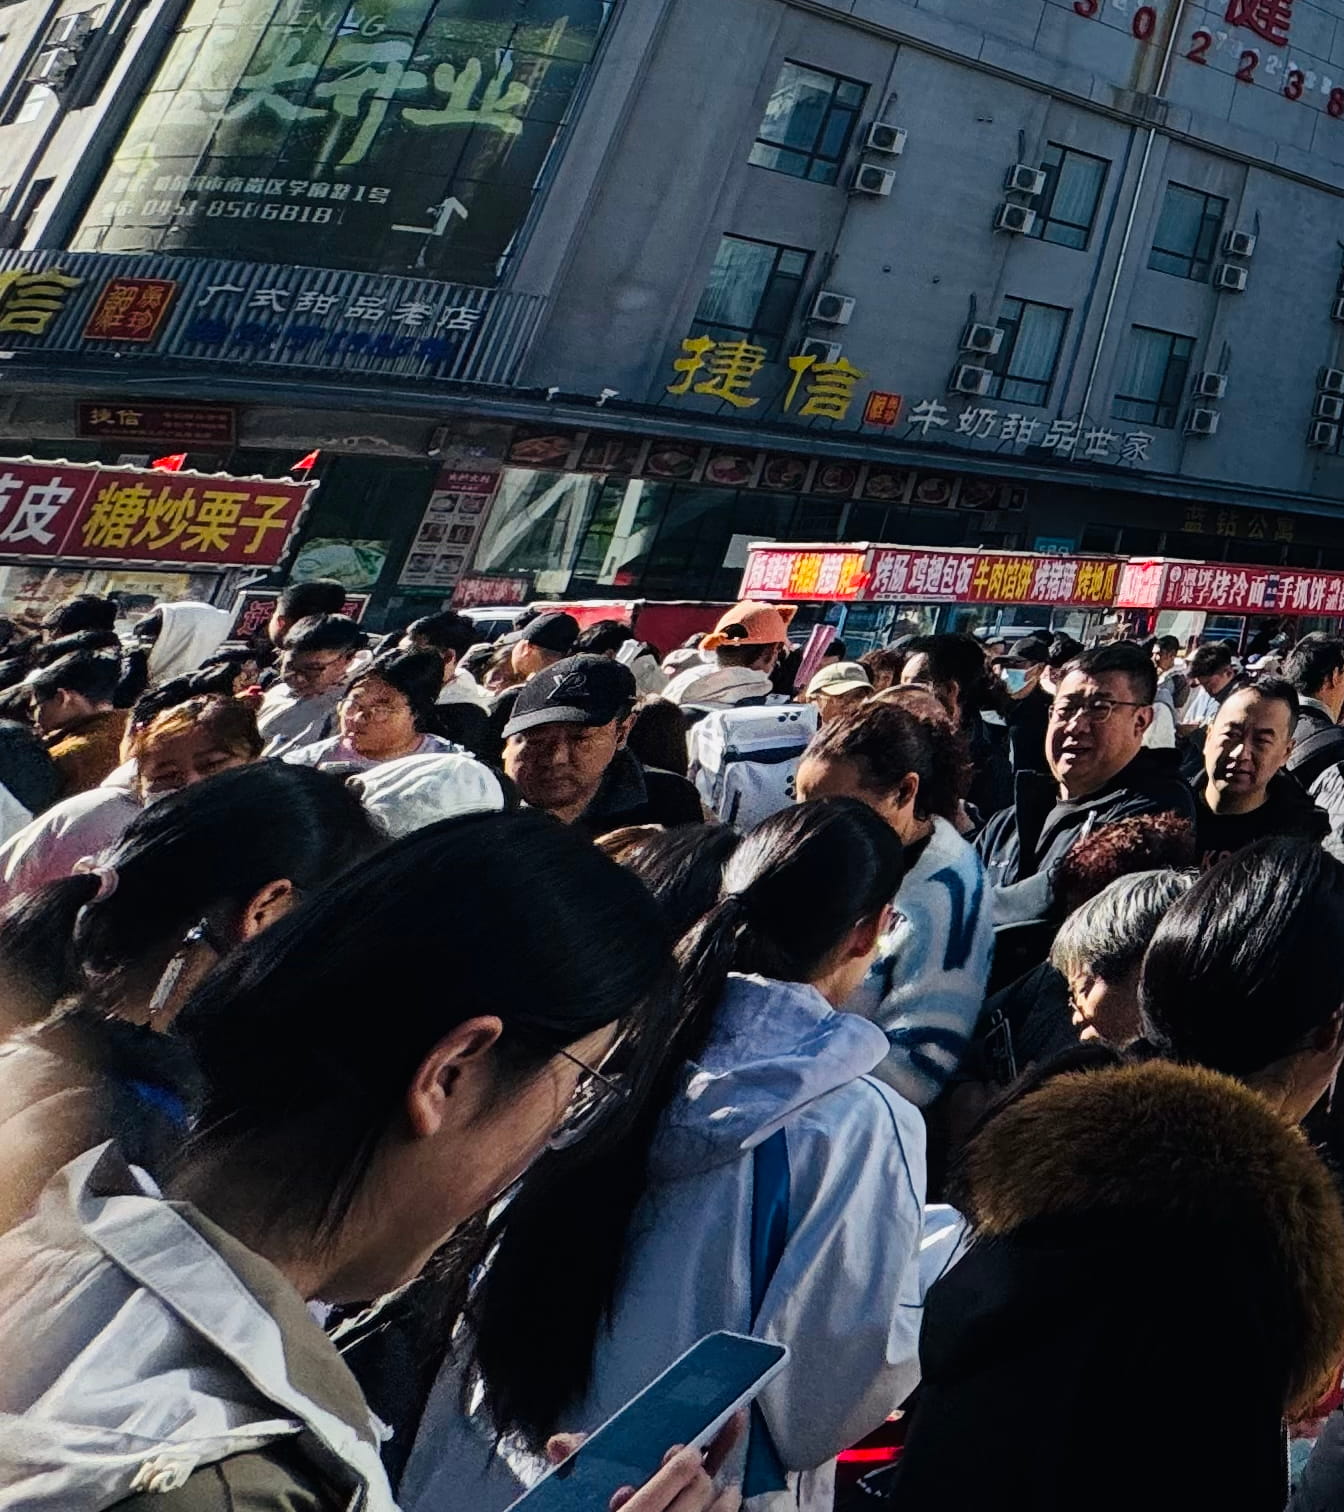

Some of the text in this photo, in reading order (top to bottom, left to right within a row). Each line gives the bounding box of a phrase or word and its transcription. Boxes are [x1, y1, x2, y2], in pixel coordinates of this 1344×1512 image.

[201, 284, 485, 332] 广式甜品老店
[666, 334, 869, 420] 捷信
[906, 397, 1158, 462] 牛奶甜品世家
[82, 481, 292, 553] 糖炒栗子
[870, 553, 911, 595] 烤肠
[908, 556, 976, 595] 鸡翅包饭
[972, 560, 1034, 600] 牛肉馅饼
[1073, 561, 1119, 602] 烤地瓜
[1208, 568, 1266, 608] 烤冷面
[1278, 574, 1328, 612] 手抓饼
